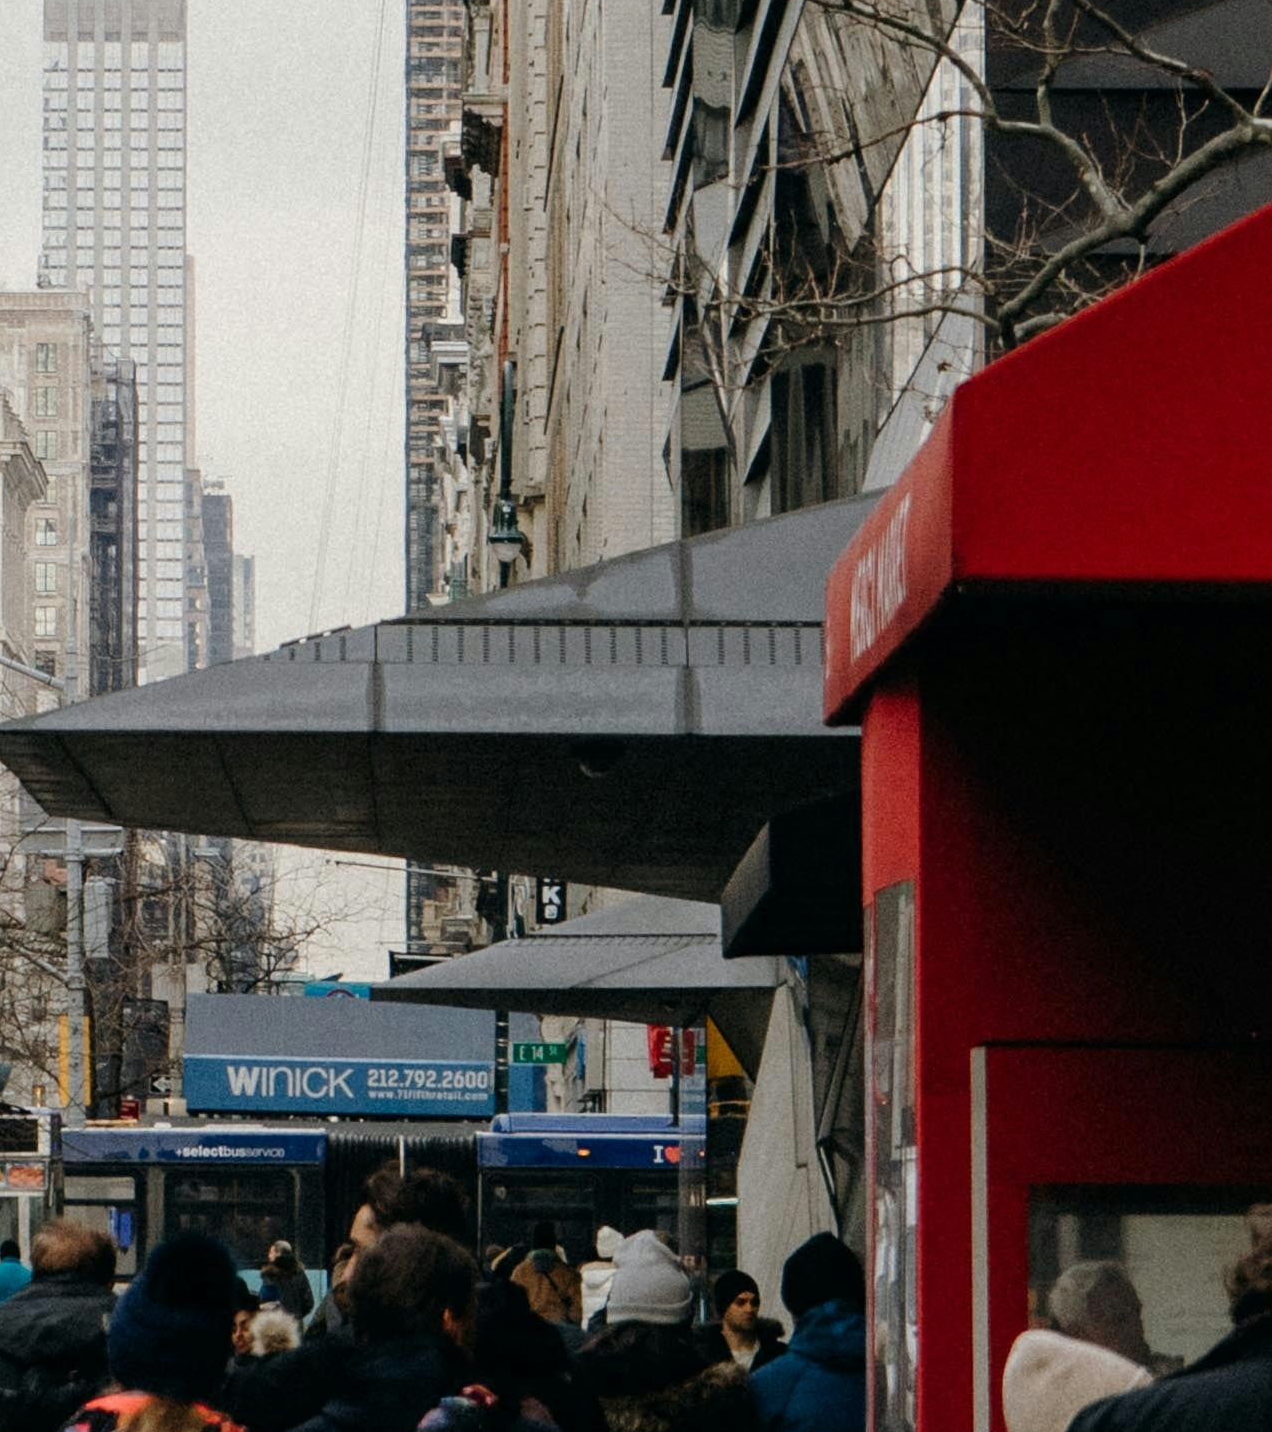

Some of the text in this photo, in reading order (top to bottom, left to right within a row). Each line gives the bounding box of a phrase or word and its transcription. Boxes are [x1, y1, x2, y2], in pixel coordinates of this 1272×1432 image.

[519, 1045, 527, 1061] E
[531, 1045, 544, 1061] 14
[366, 1068, 489, 1090] 212.792.2600
